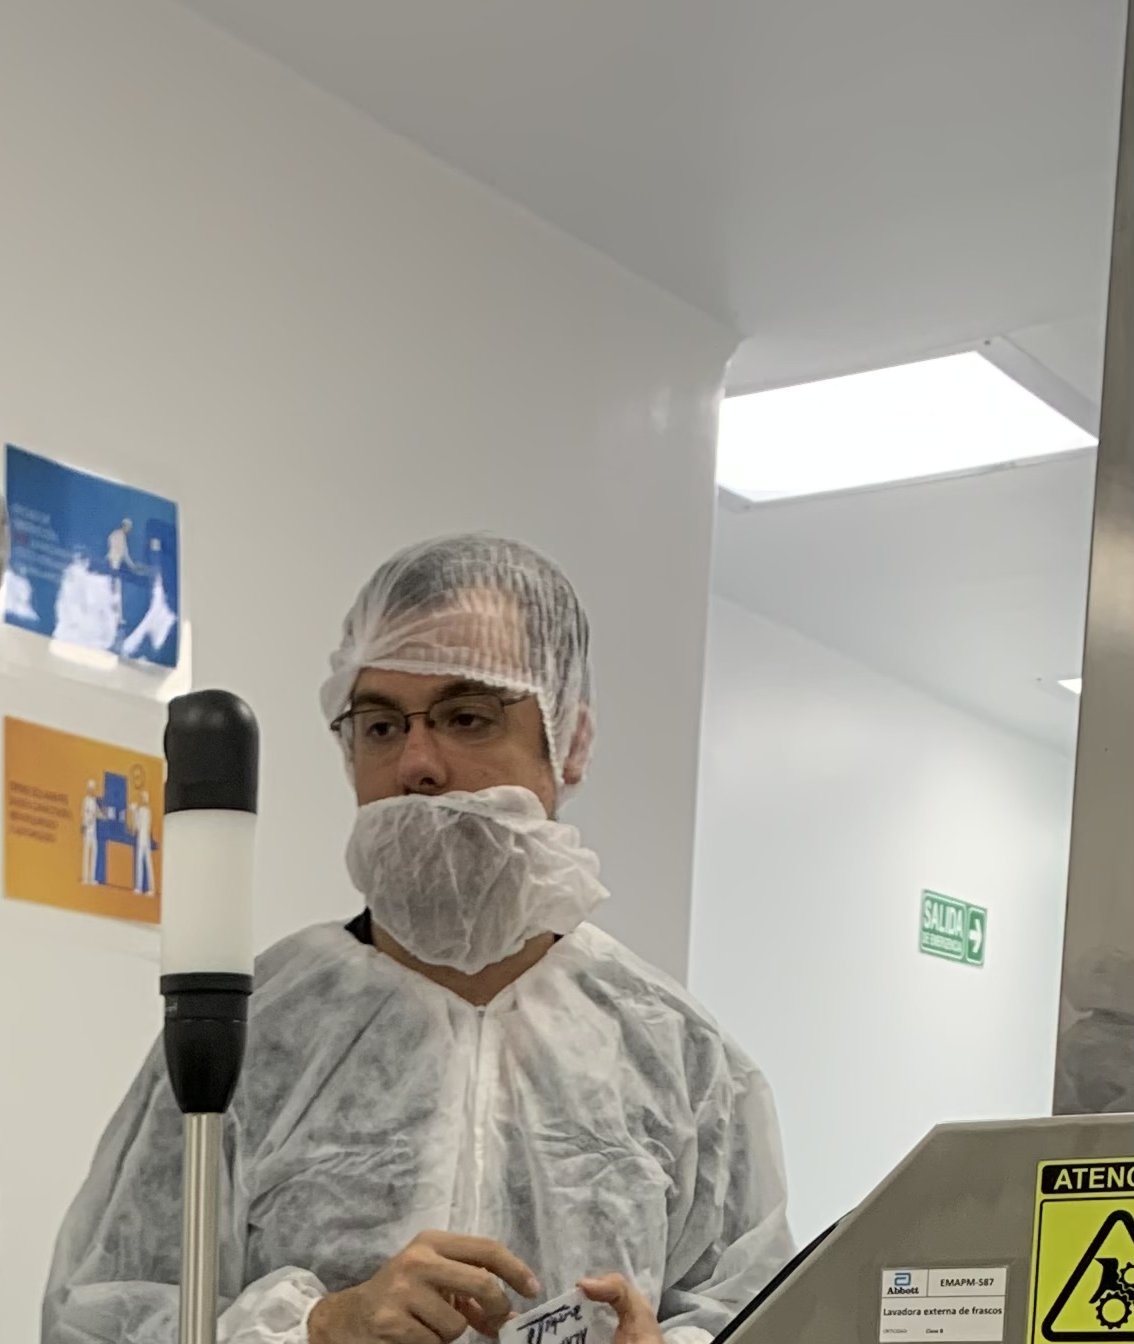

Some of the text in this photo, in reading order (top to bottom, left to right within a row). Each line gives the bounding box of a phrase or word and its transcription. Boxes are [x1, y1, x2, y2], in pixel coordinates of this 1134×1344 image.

[923, 899, 963, 939] SALIDA
[940, 1278, 995, 1287] EMAPM-587
[887, 1286, 920, 1295] Abbott
[883, 1306, 1003, 1317] Lavadora externa de frascos
